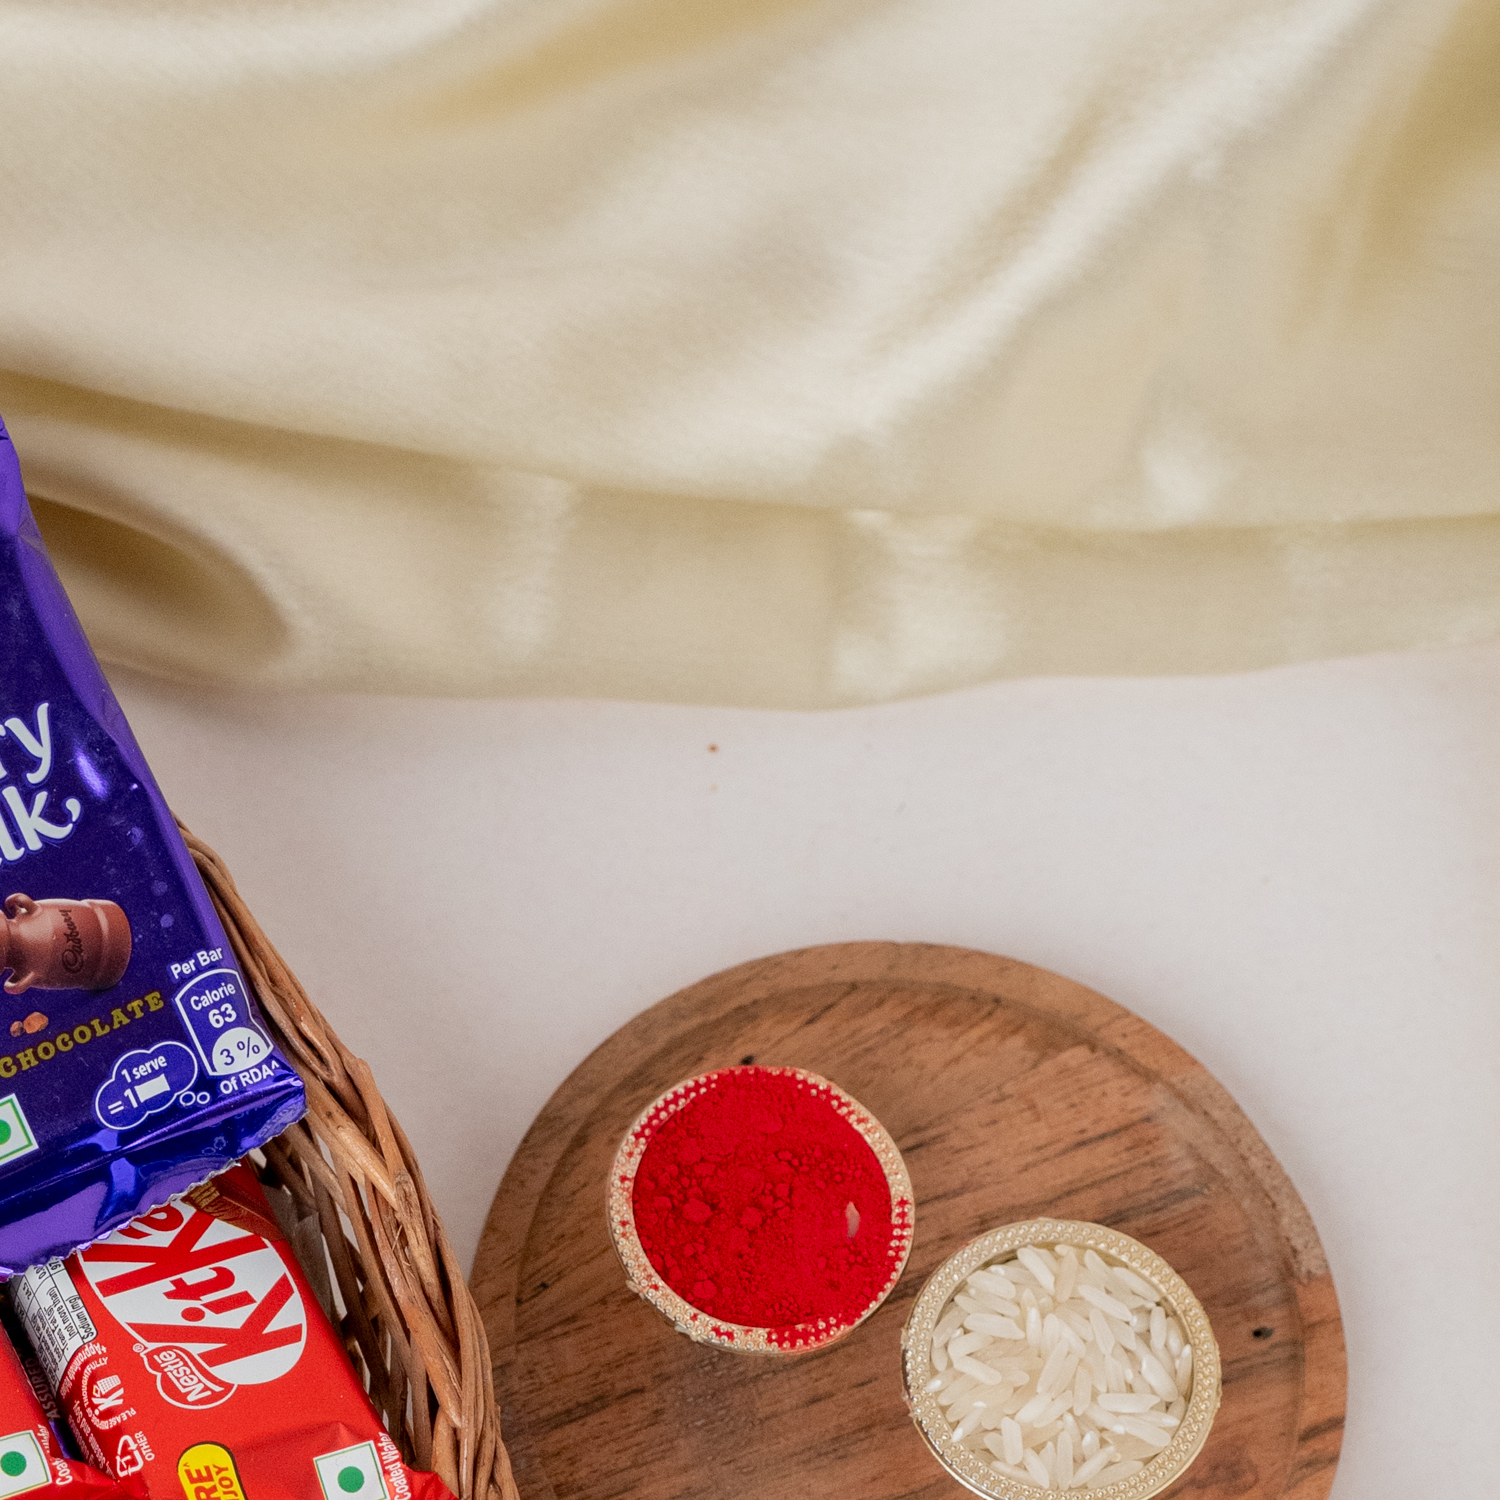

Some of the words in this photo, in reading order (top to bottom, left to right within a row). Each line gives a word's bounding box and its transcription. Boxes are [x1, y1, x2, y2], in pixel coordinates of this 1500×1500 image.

[62, 909, 85, 973] Cadbury
[171, 959, 195, 980] Per
[197, 946, 223, 968] Bar
[190, 981, 236, 1012] Calorie
[209, 1003, 237, 1029] 63
[133, 1054, 167, 1077] serve
[220, 1077, 239, 1095] Of
[75, 1309, 94, 1339] Sodium
[133, 1429, 155, 1462] OTHER
[379, 1433, 400, 1467] Wafer
